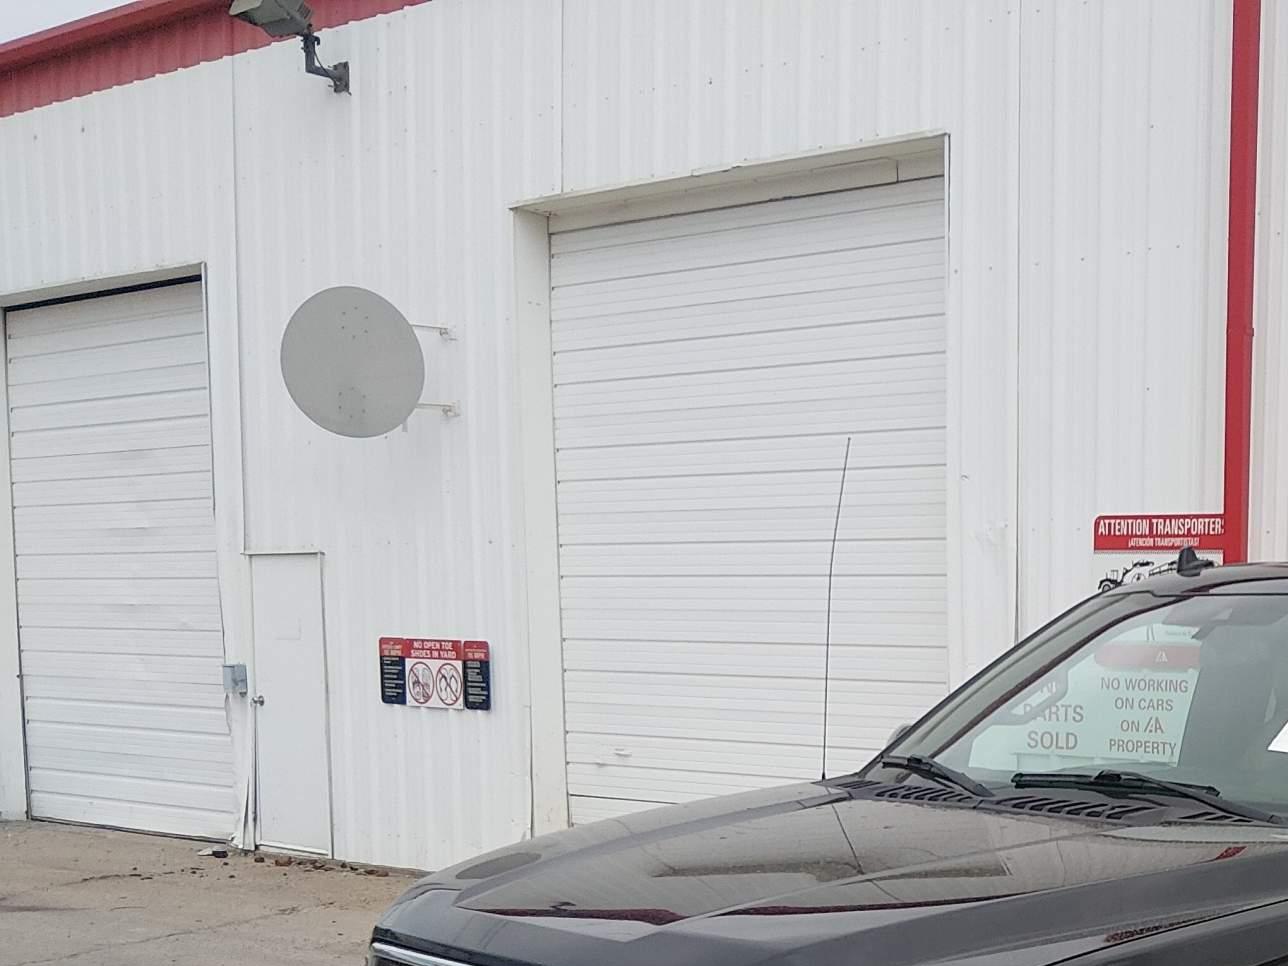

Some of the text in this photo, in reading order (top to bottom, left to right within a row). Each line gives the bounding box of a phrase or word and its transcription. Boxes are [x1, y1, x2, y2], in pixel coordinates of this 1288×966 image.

[1098, 519, 1149, 536] ATTENTION
[413, 641, 453, 650] NO OPEN TOE
[411, 649, 431, 658] SHOES
[432, 650, 439, 658] IN
[440, 650, 457, 659] YARD
[1101, 677, 1189, 693] NO WORKING
[1114, 697, 1174, 712] ON CARS
[1120, 719, 1140, 733] ON
[1027, 730, 1078, 750] SOLD
[1109, 738, 1177, 756] PROPERTY
